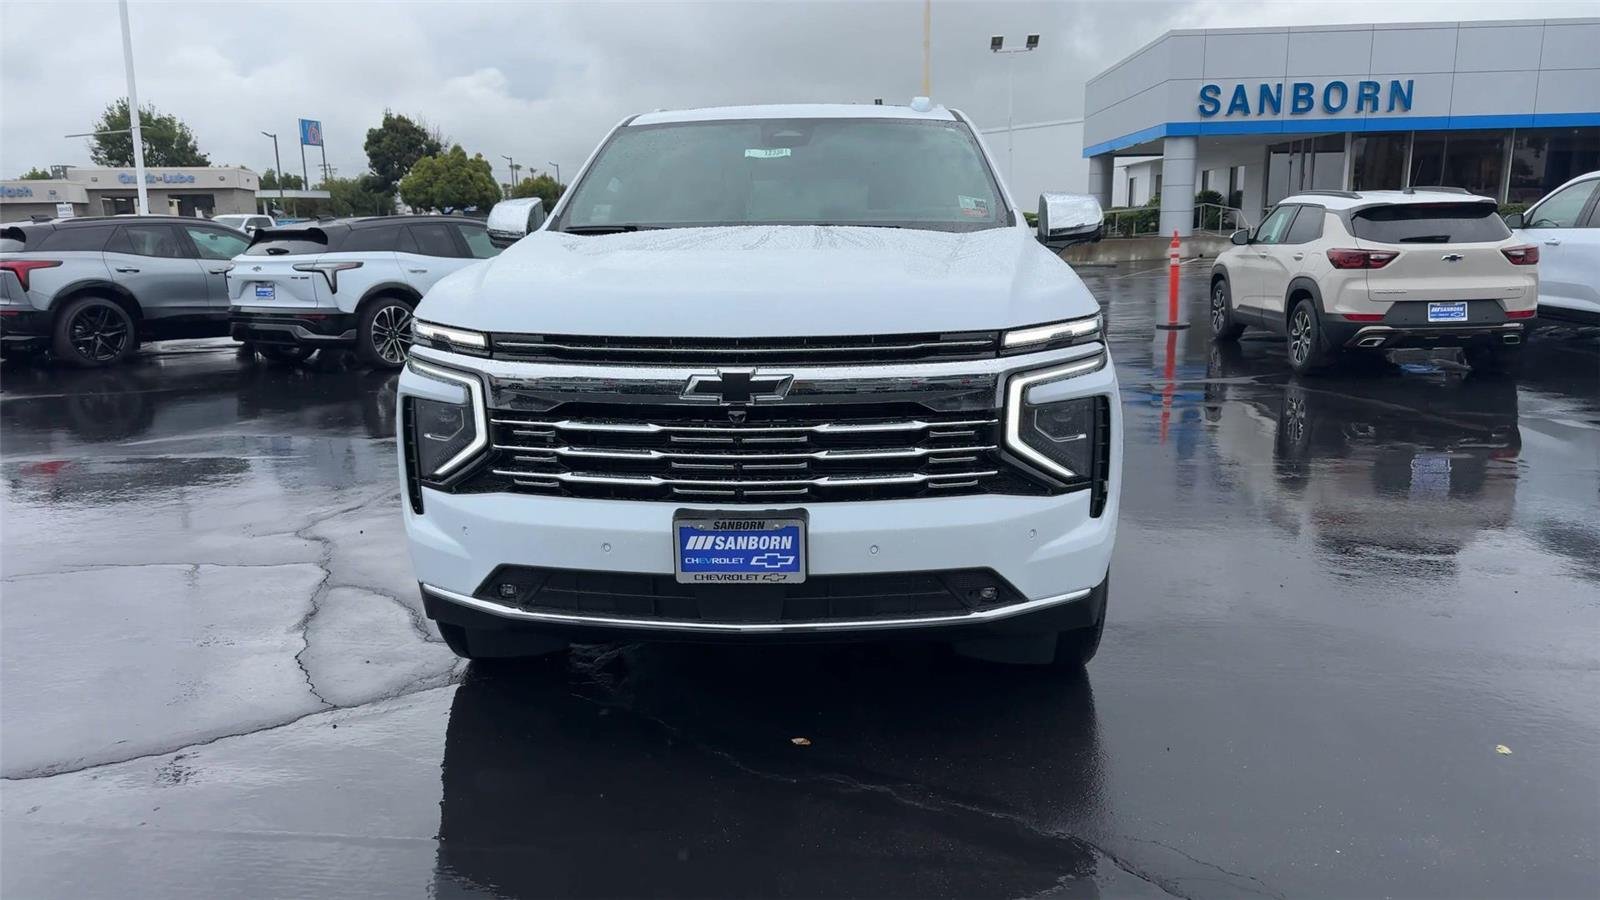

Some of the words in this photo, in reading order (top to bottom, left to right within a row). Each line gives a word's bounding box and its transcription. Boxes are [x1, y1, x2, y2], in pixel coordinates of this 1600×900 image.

[1198, 79, 1415, 117] SANBORN
[118, 172, 156, 185] Quk
[713, 520, 765, 530] SANBORN
[714, 535, 793, 550] SANBORN
[685, 557, 745, 565] CHEVROLET
[693, 573, 760, 581] CHEVROLET
